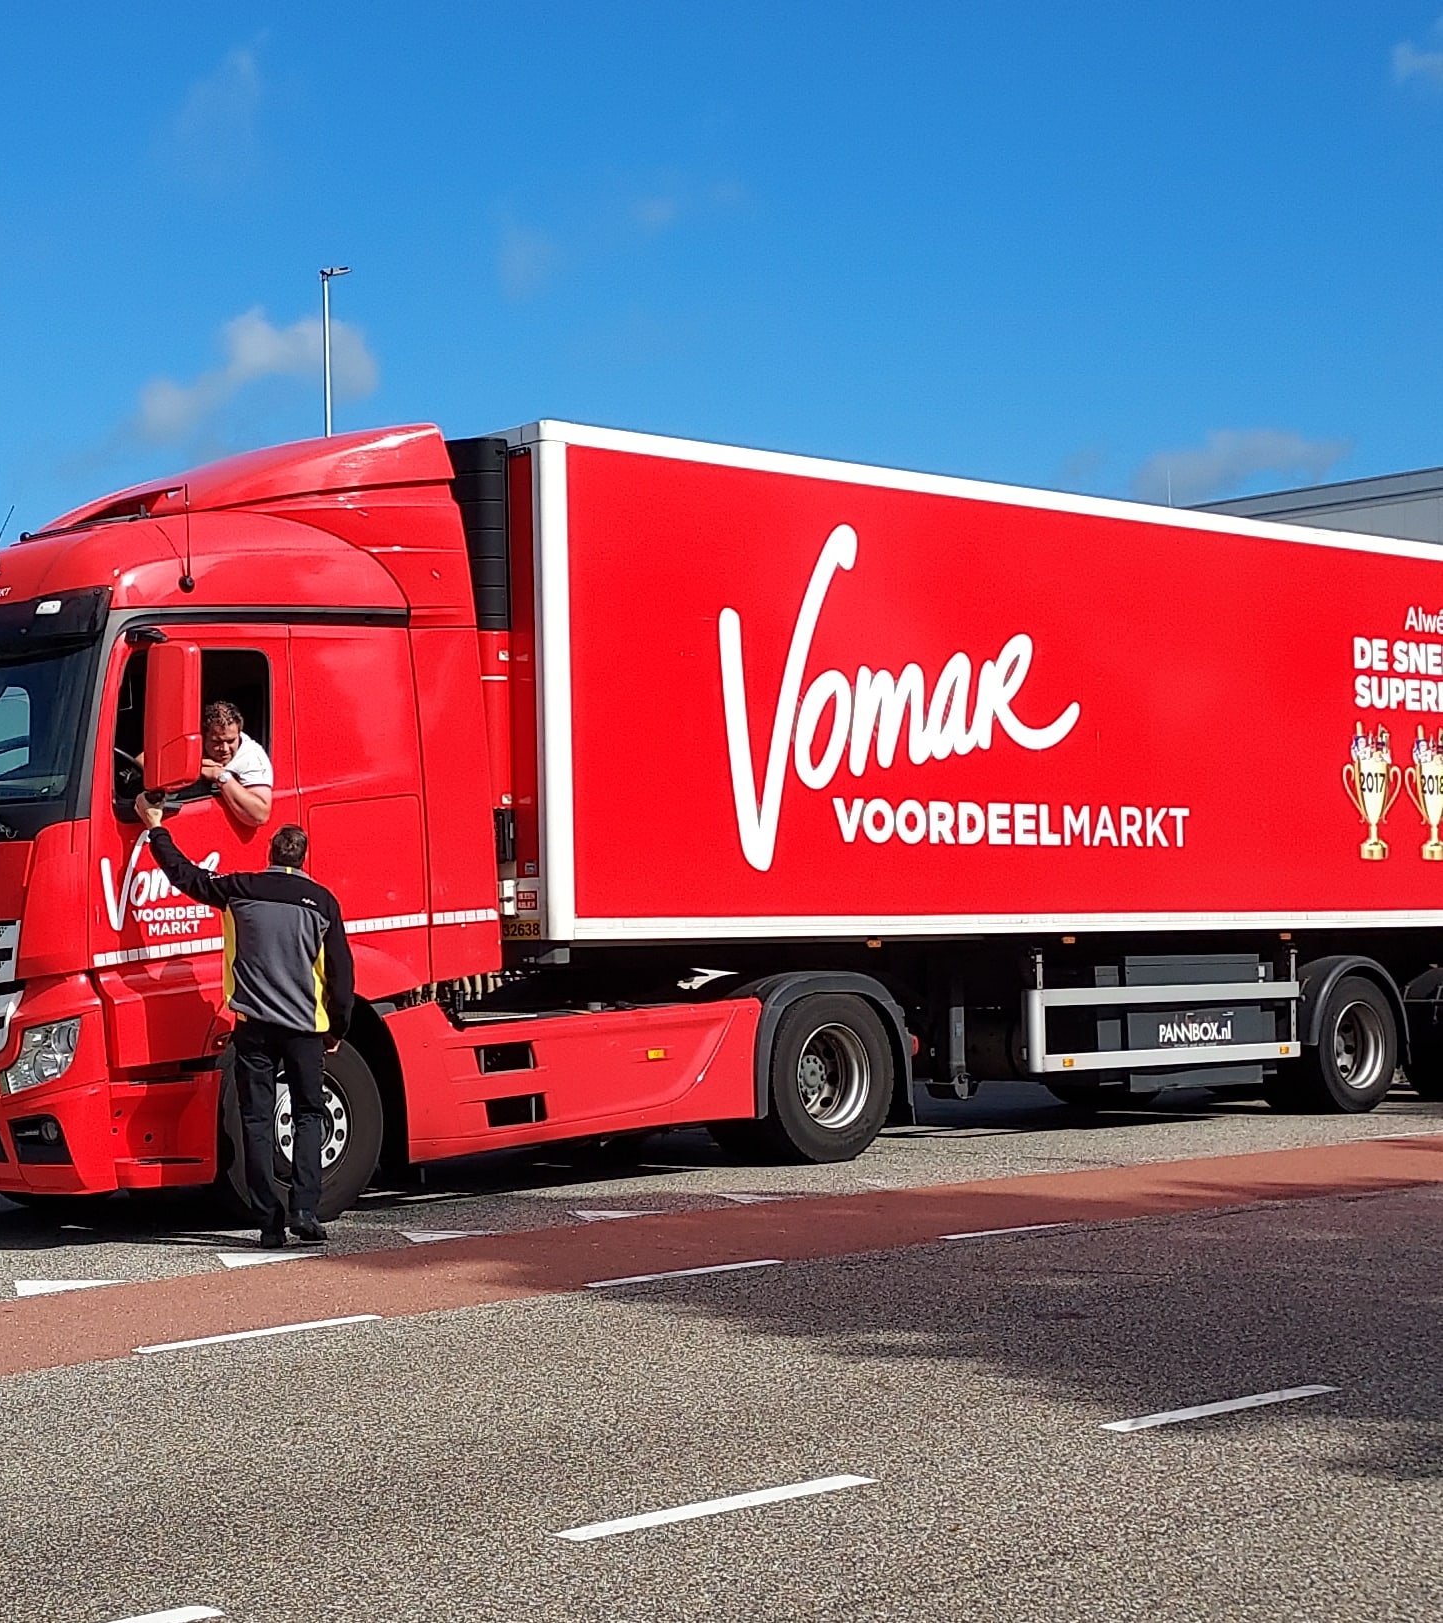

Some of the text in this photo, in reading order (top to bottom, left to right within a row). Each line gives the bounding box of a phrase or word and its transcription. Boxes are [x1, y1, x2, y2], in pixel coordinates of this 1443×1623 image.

[1353, 636, 1443, 676] DE SNE
[1360, 772, 1386, 793] 2017
[833, 797, 1191, 848] VOORDEELMARKT
[132, 905, 214, 923] VOORDEEL
[148, 920, 200, 937] MARKT
[502, 923, 540, 937] 32638
